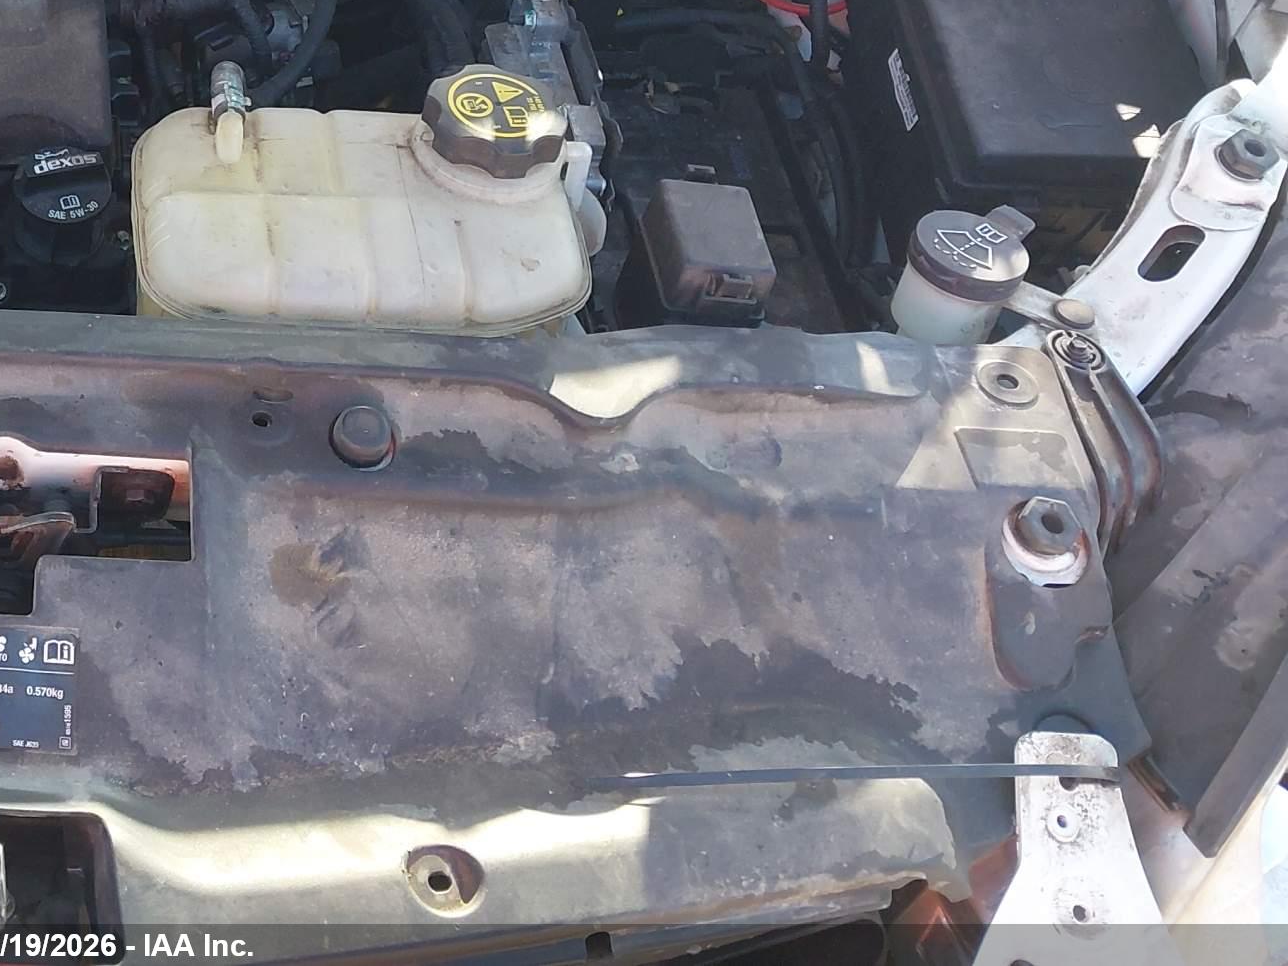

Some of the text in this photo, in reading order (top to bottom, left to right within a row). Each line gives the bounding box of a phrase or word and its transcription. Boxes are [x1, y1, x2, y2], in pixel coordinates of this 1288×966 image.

[33, 154, 97, 174] dexos
[48, 200, 99, 220] SAE 5W-30
[26, 685, 64, 699] 0.570kg
